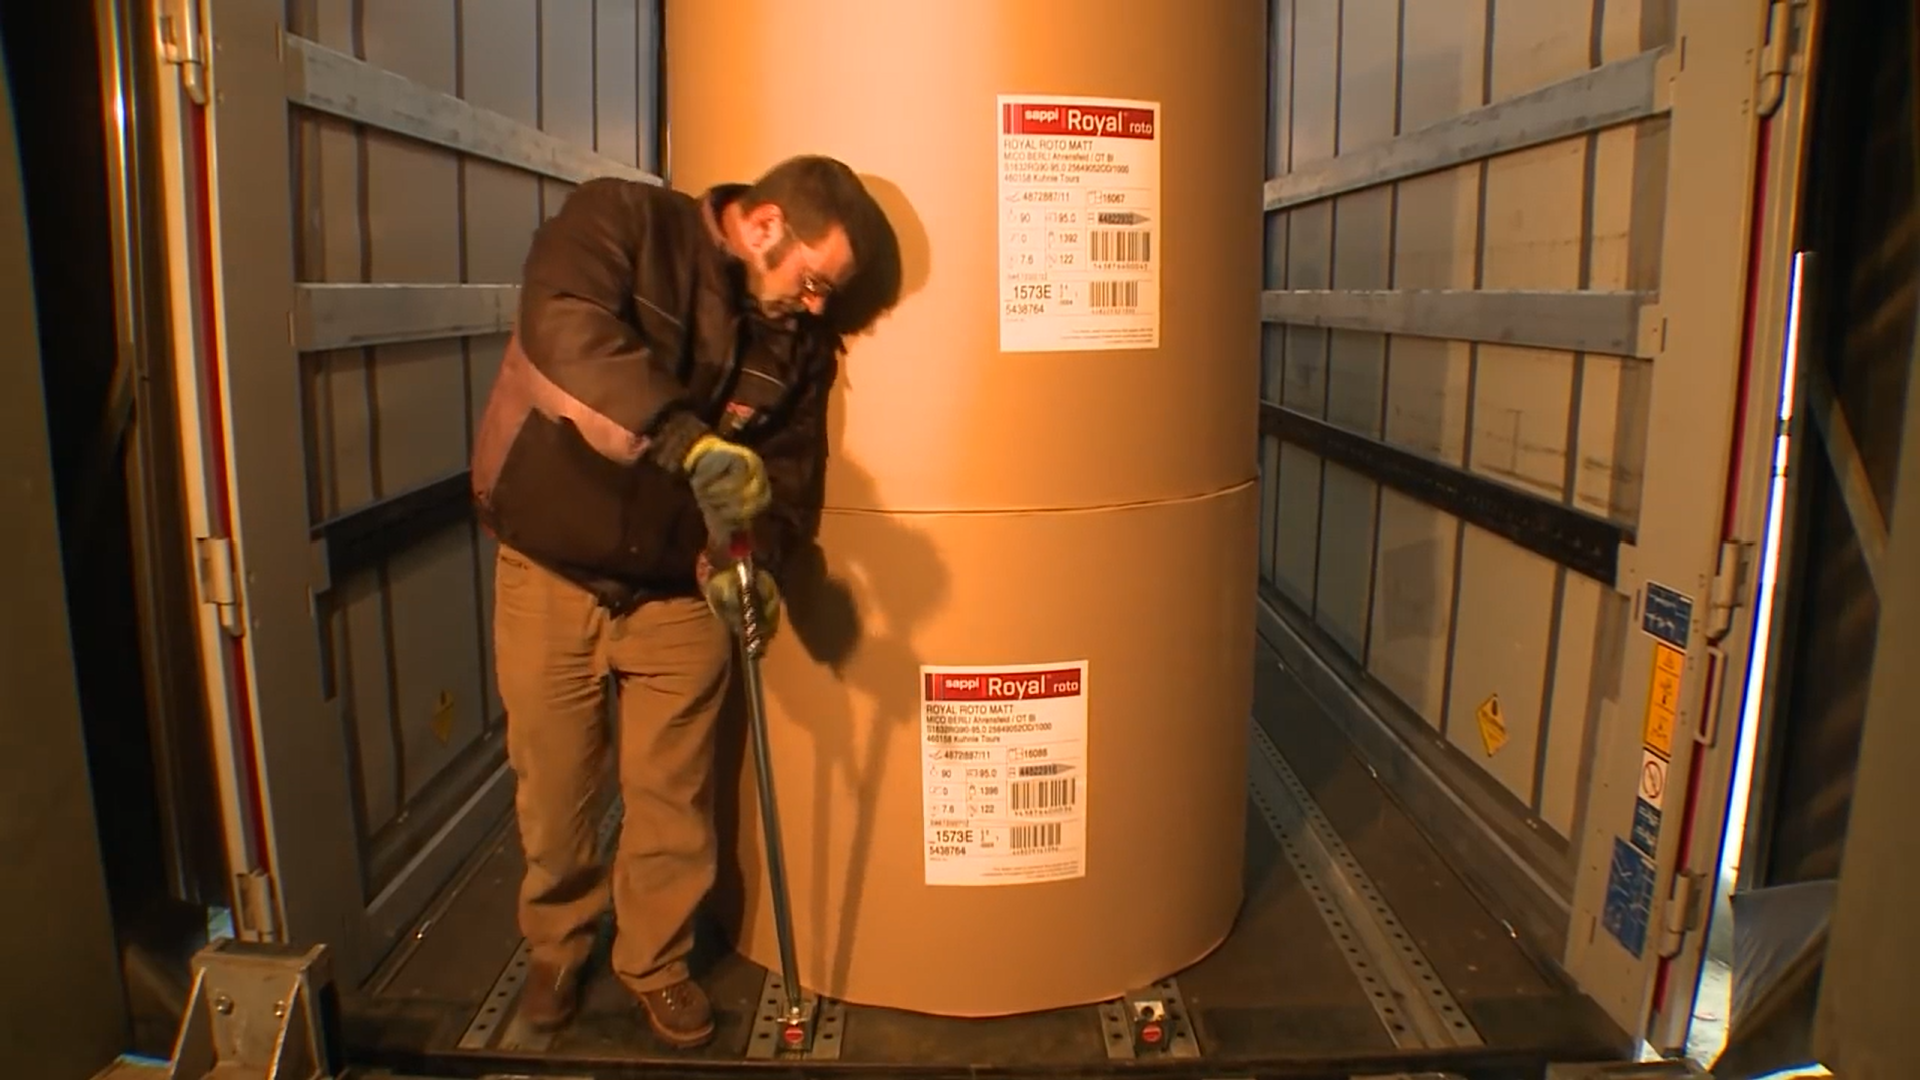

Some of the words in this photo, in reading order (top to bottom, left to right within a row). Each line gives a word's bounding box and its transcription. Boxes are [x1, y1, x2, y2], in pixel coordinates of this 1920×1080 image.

[1025, 108, 1058, 122] sappi
[1068, 109, 1122, 136] Royal
[1130, 123, 1152, 133] roto
[1004, 139, 1036, 149] ROYAL
[1040, 139, 1066, 150] ROTO
[1069, 140, 1093, 150] MATT
[1020, 213, 1030, 222] 90
[1060, 254, 1074, 264] 122
[1006, 303, 1044, 315] 5438764
[946, 678, 979, 690] sappi
[988, 675, 1045, 700] Royal
[1053, 680, 1078, 693] roto
[926, 704, 957, 714] ROYAL
[959, 705, 987, 714] ROTO
[989, 704, 1013, 714] MATT
[942, 769, 951, 778] 90
[981, 805, 994, 813] 122
[930, 846, 966, 856] 5438764
